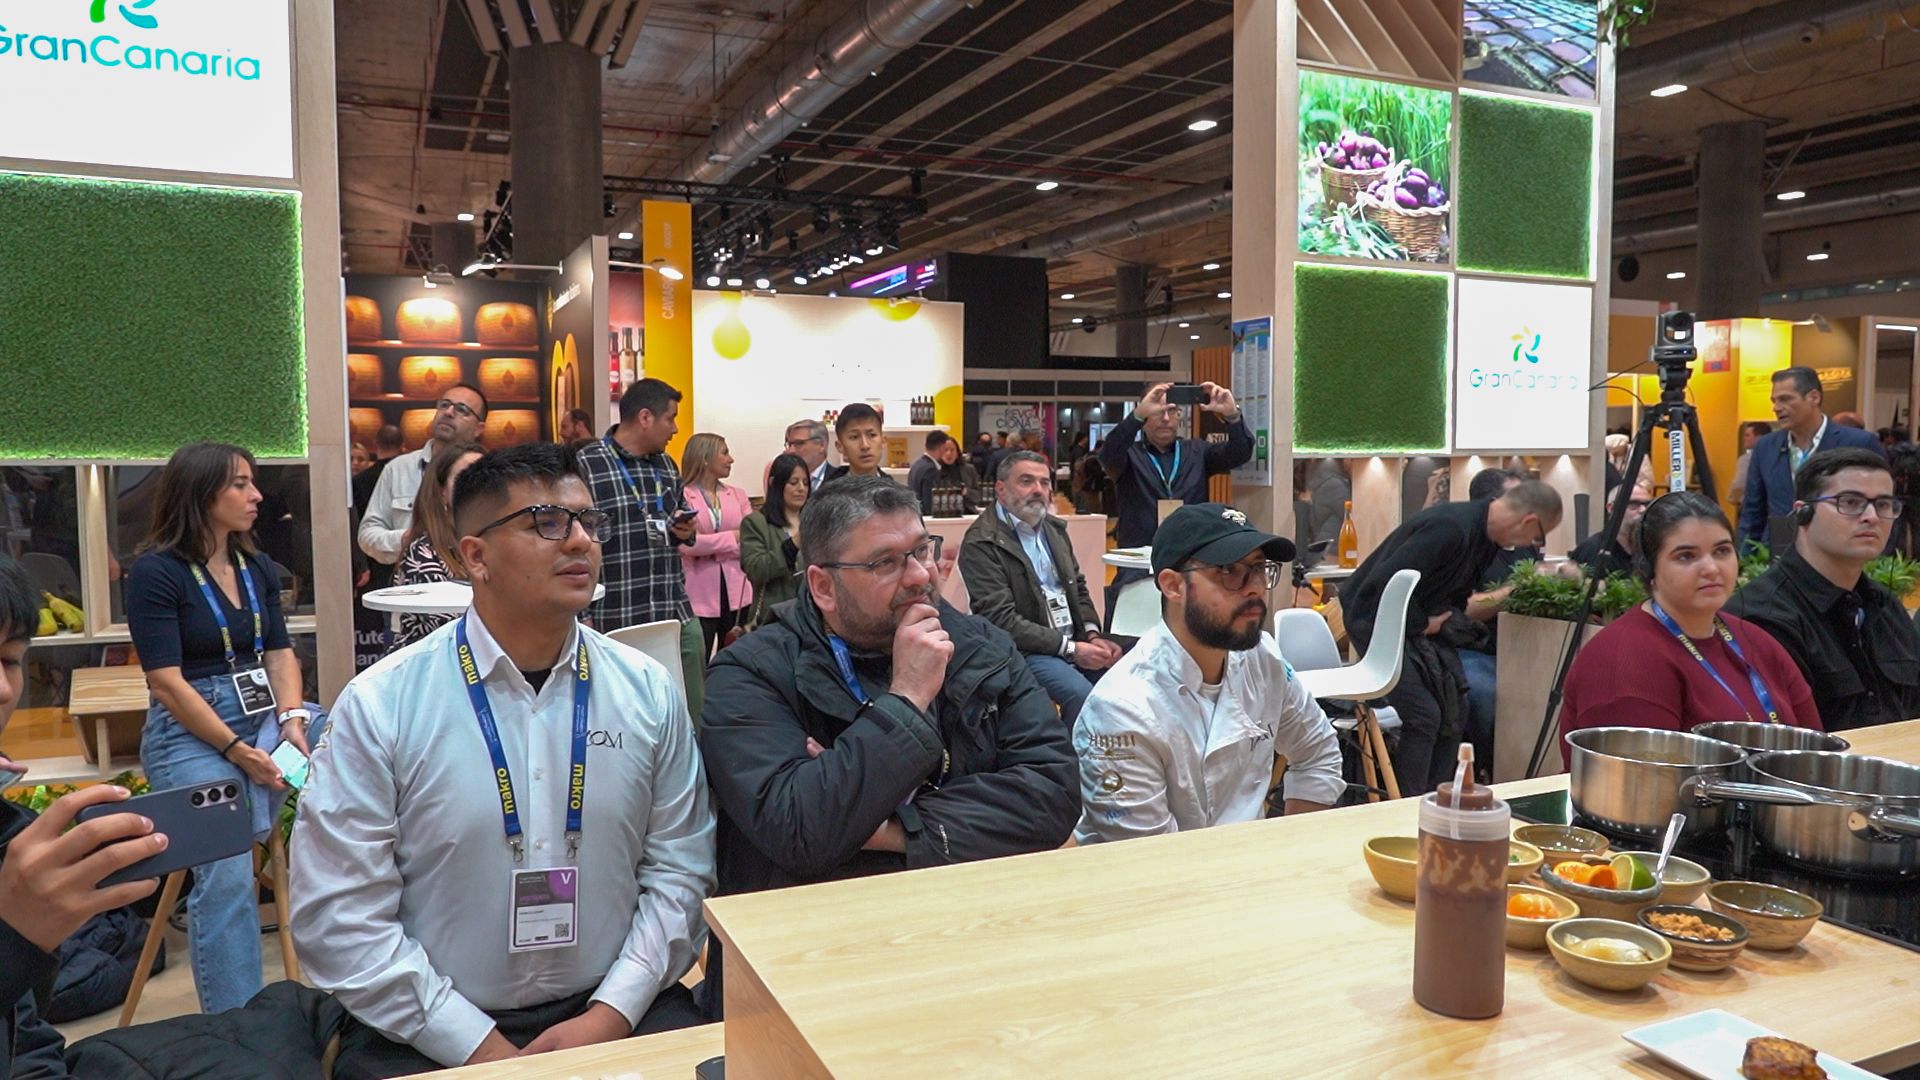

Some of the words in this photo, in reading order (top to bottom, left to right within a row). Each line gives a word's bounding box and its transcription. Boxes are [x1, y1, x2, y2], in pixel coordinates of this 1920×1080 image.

[1469, 368, 1578, 390] GranCanara
[1671, 432, 1682, 472] MILLER
[459, 645, 479, 685] makro
[579, 643, 589, 681] makro
[1678, 634, 1703, 661] makro
[496, 768, 515, 814] makro
[570, 764, 584, 810] makro
[561, 872, 572, 885] V
